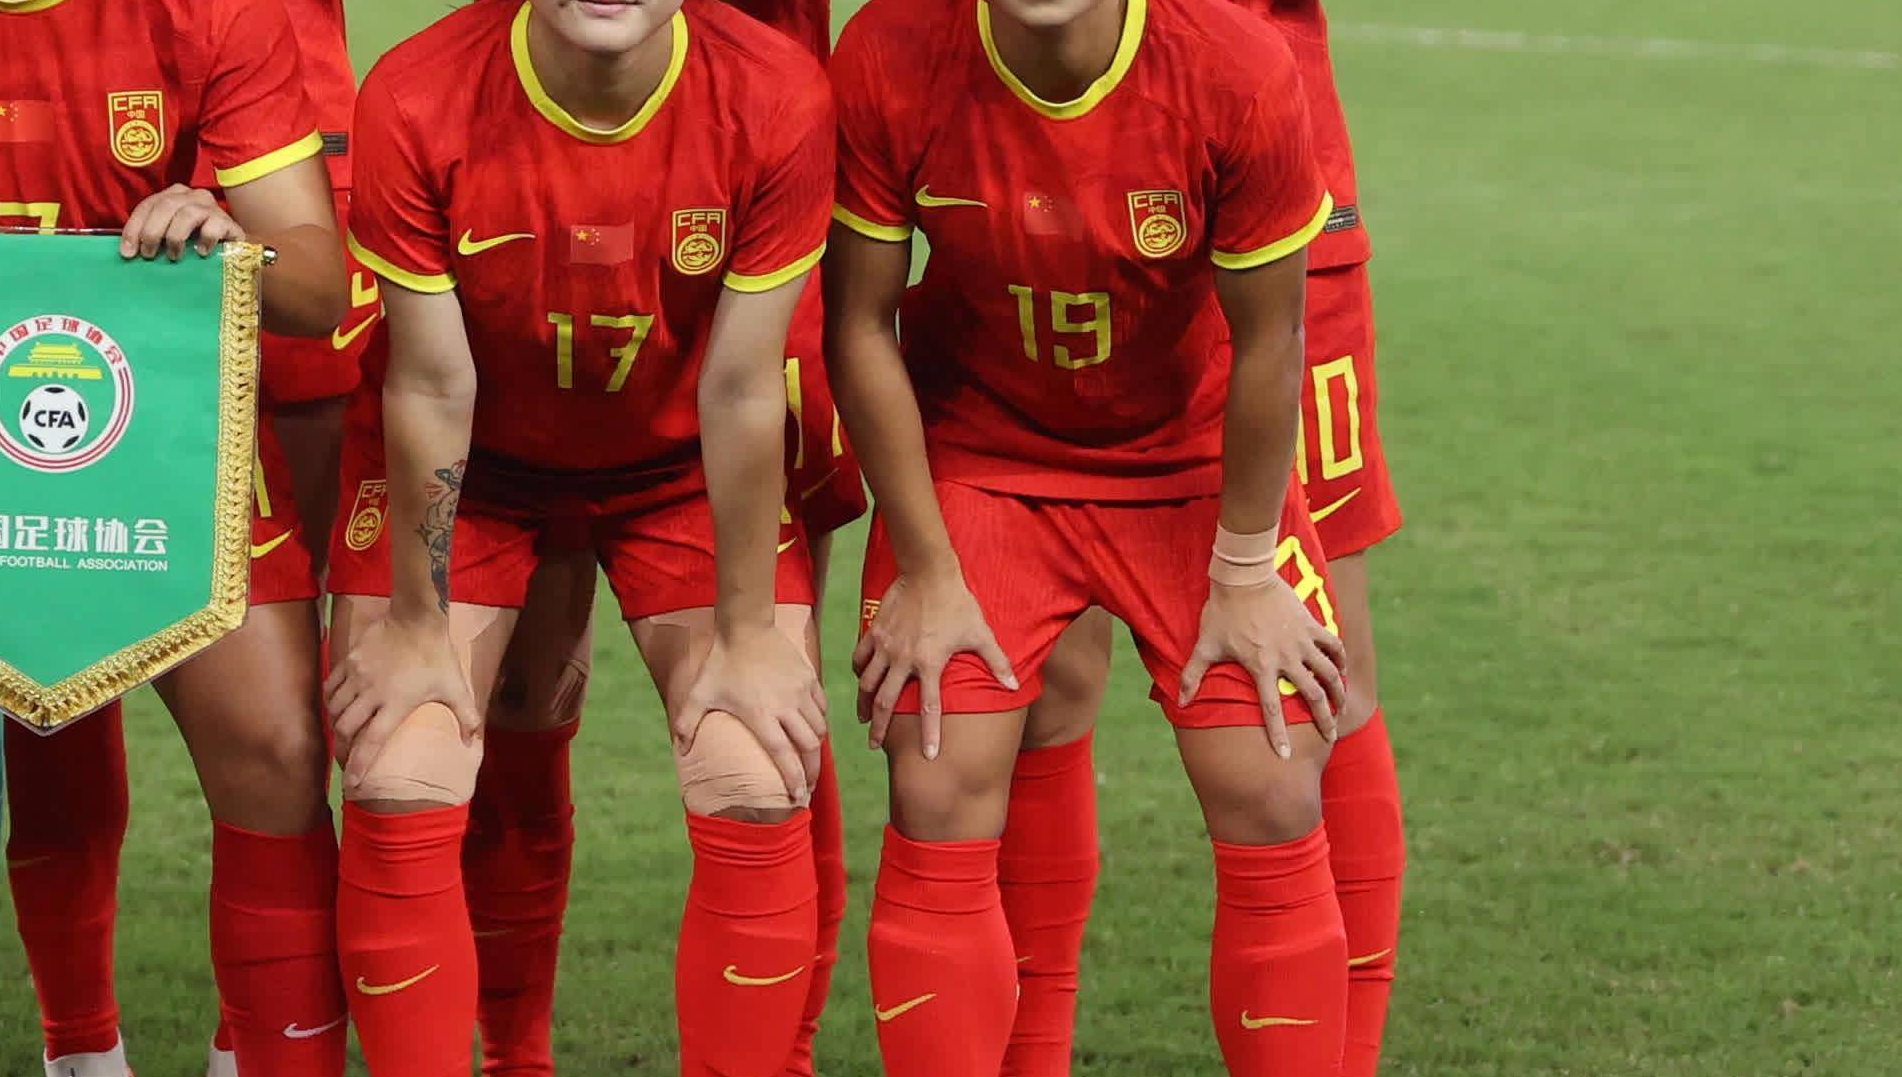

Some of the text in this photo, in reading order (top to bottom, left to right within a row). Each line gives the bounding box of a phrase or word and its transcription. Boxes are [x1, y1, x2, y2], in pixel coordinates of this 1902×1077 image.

[113, 95, 158, 112] CFA
[1133, 193, 1178, 209] CFA
[677, 212, 721, 228] CFA
[1008, 284, 1112, 370] 19
[547, 312, 655, 392] 17
[33, 409, 75, 429] CFA
[0, 555, 71, 570] FOOTBALL
[77, 557, 169, 572] ASSOCIATION
